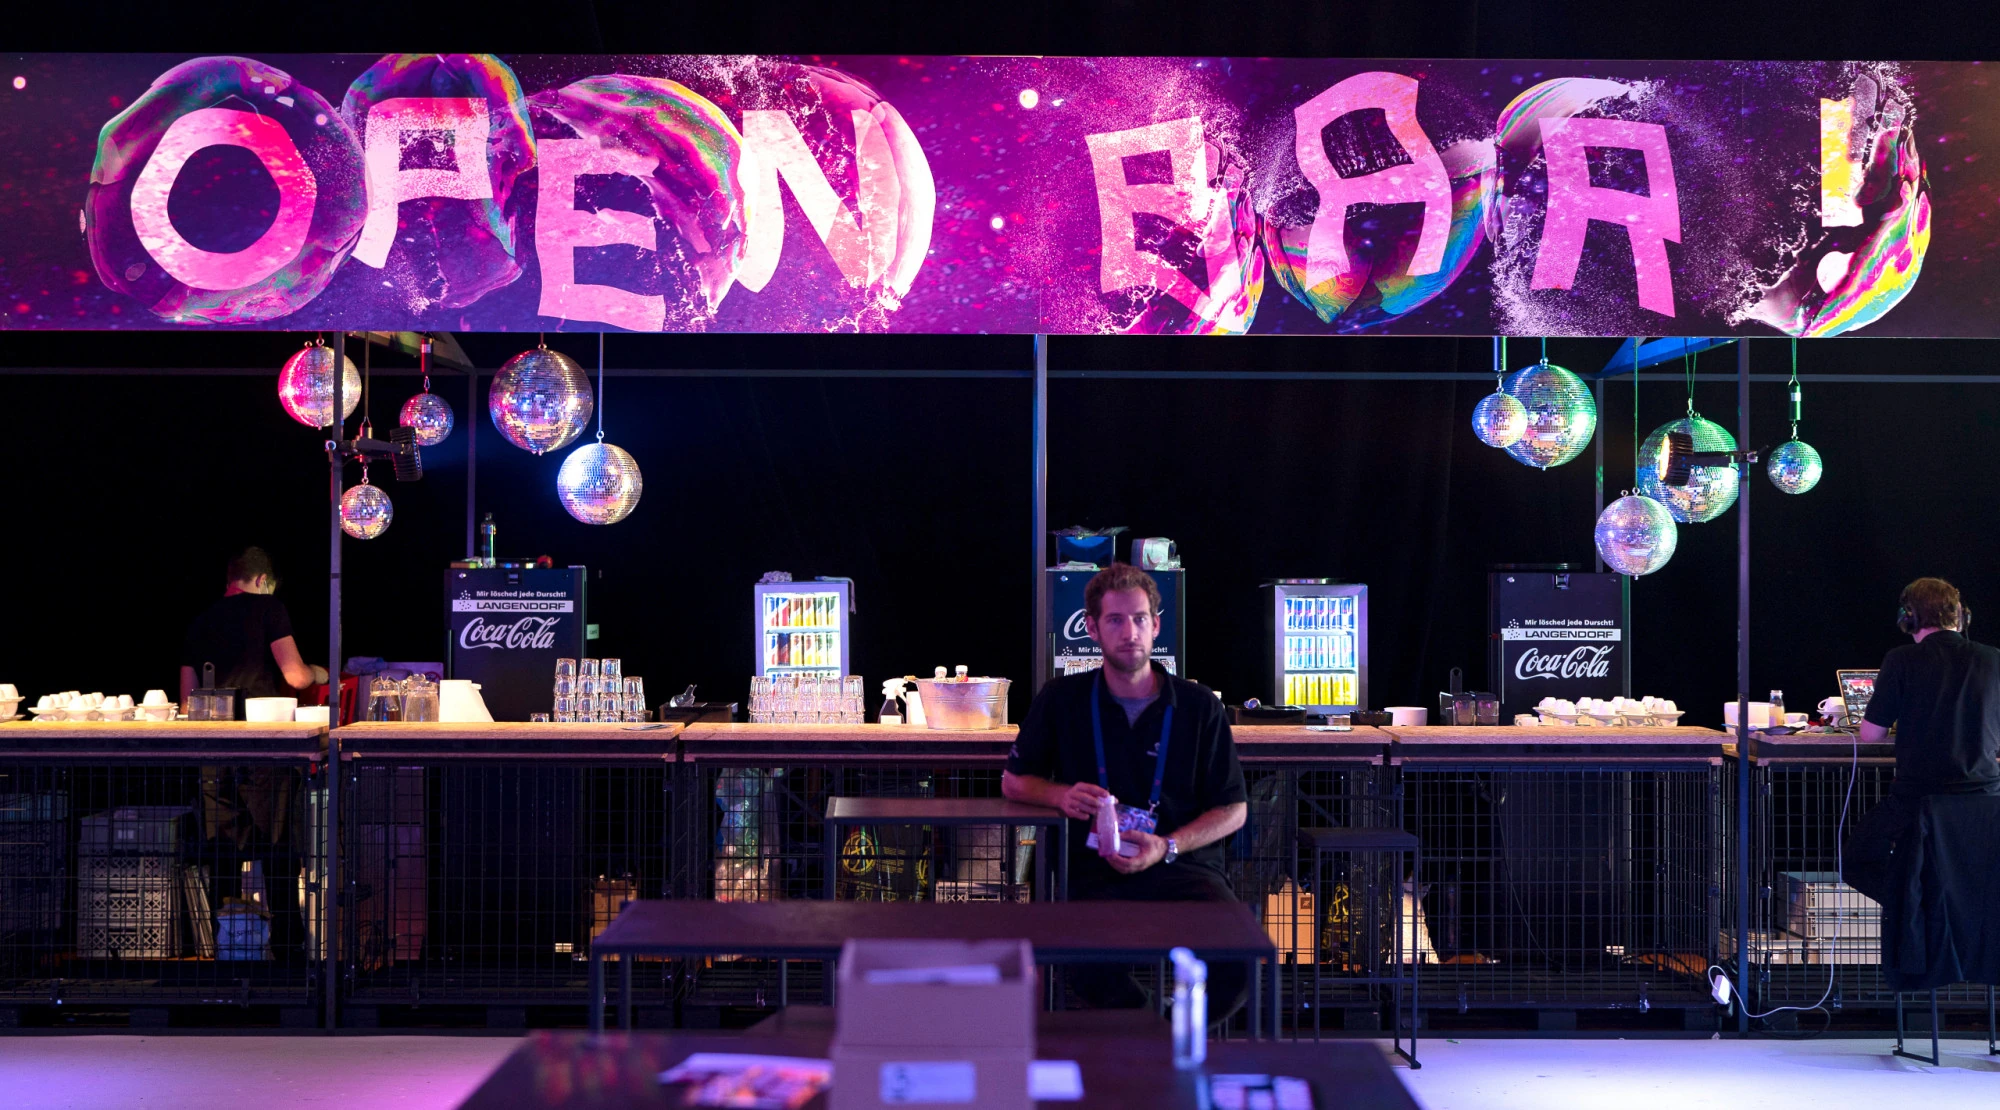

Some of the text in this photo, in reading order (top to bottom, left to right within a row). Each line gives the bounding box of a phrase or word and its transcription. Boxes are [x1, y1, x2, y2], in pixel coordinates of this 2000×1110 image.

[131, 96, 899, 332] OPEN
[490, 590, 518, 598] lösched
[519, 591, 535, 599] jede
[476, 601, 566, 610] LANGENDORF
[1567, 619, 1583, 627] jede
[459, 616, 561, 650] Coca-Cola
[1525, 630, 1613, 638] LANGENDORF
[1514, 645, 1615, 681] Coca-Cola
